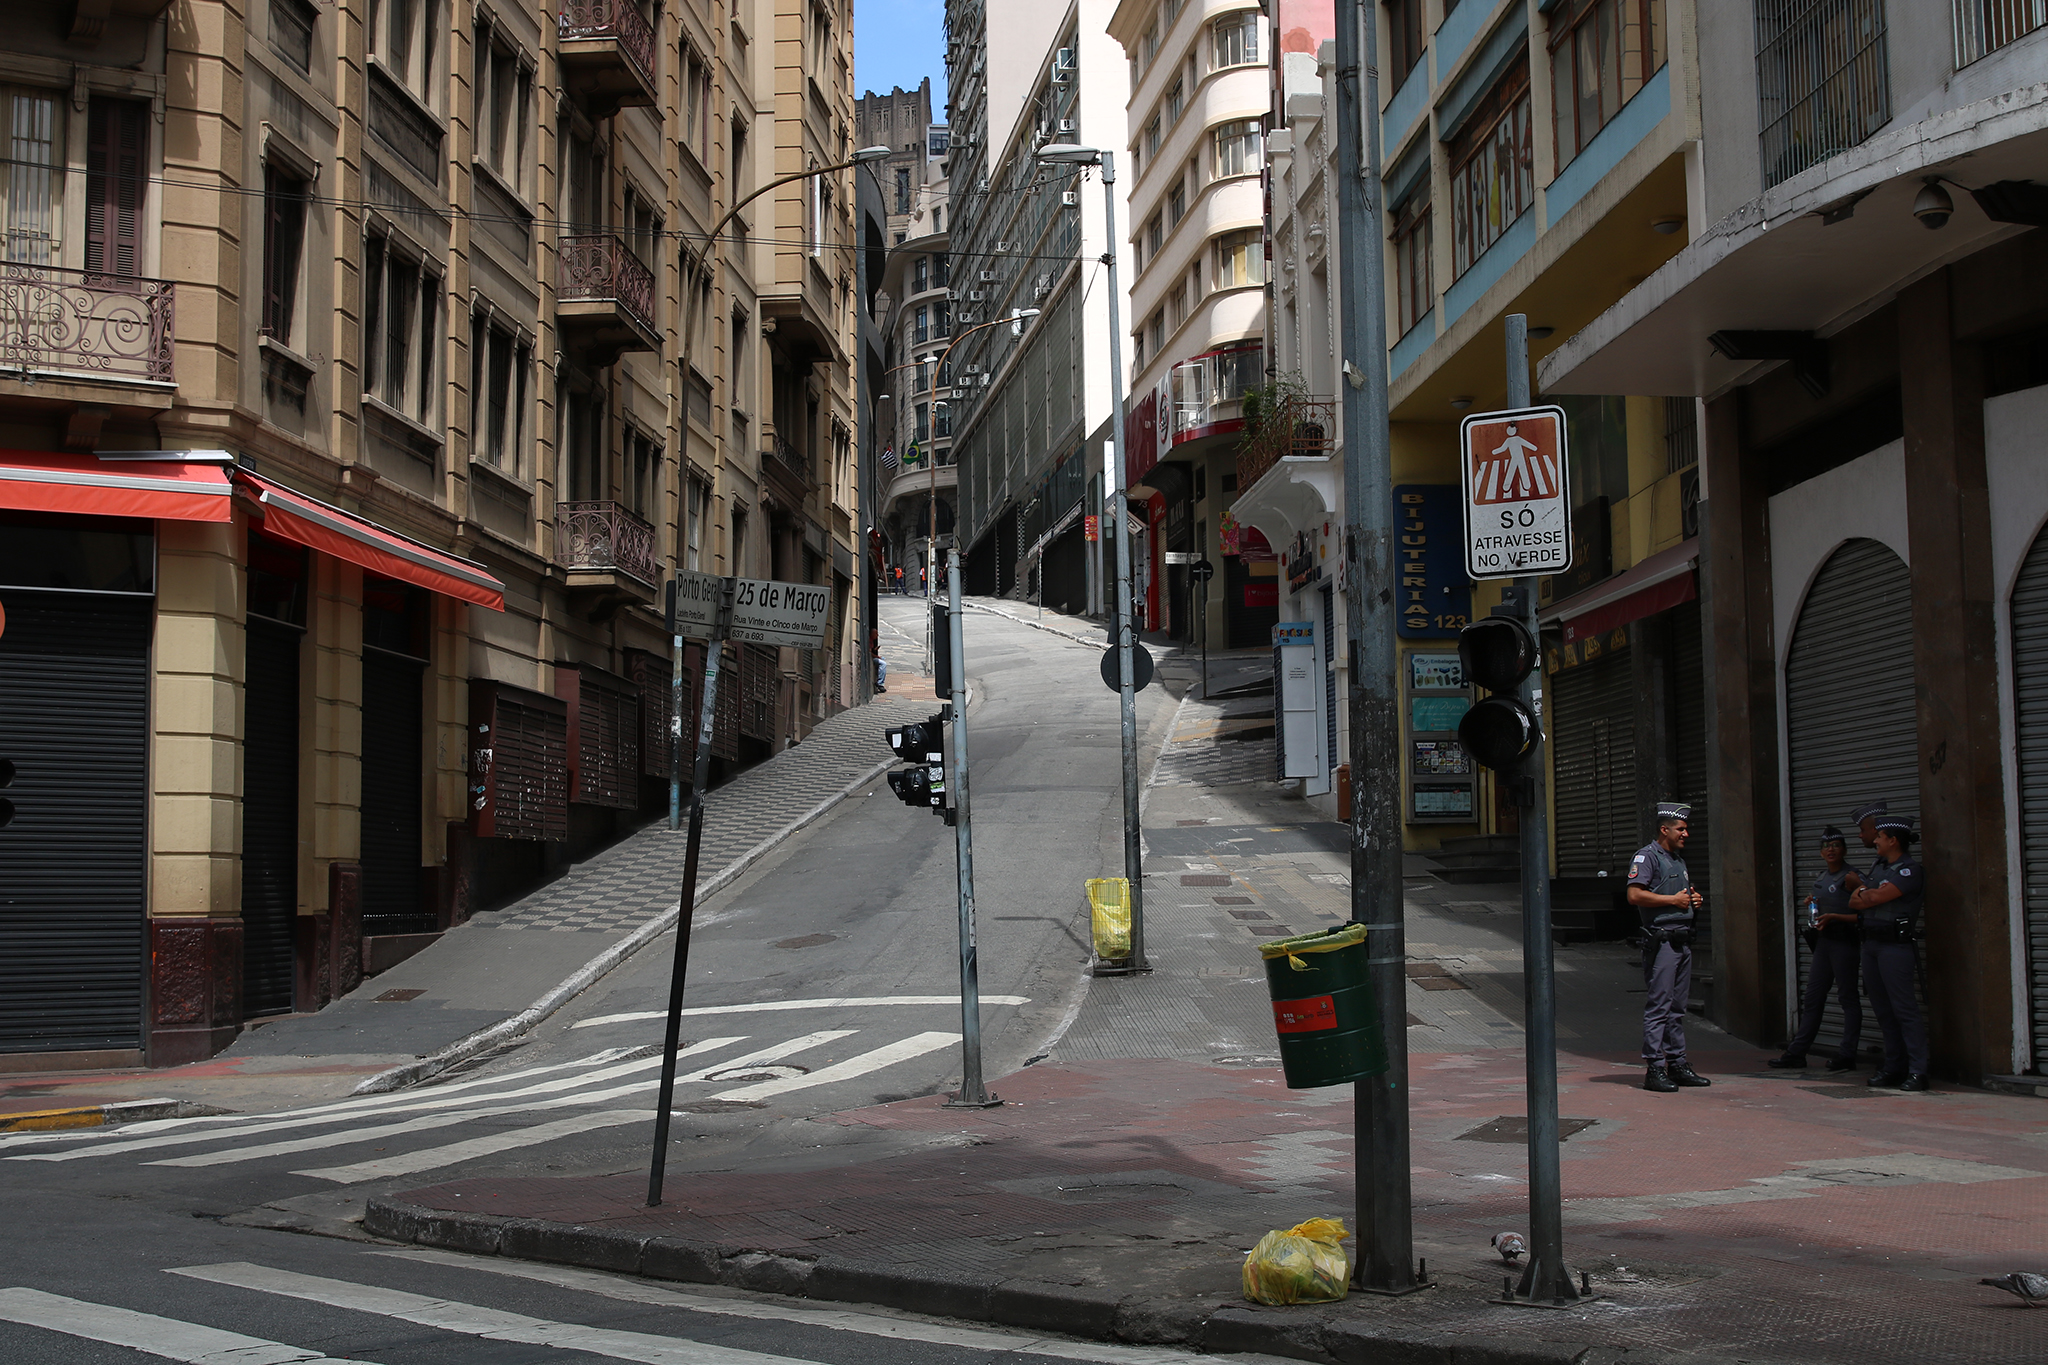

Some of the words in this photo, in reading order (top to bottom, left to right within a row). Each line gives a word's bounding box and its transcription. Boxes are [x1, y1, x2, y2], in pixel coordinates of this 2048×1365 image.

[1500, 503, 1535, 529] SÓ
[1475, 530, 1562, 551] ATRAVESSE
[1401, 494, 1429, 629] BIJUTERIAS
[1478, 553, 1500, 567] NO
[1508, 548, 1561, 565] VERDE
[677, 573, 700, 600] Porto
[702, 578, 717, 603] Gera
[737, 582, 755, 606] 25
[759, 583, 779, 608] de
[783, 586, 826, 619] Março
[734, 614, 746, 624] Rua
[748, 616, 764, 626] Vinte
[772, 620, 790, 629] Cinco
[792, 622, 800, 630] de
[801, 622, 818, 633] Março
[1434, 614, 1466, 629] 123
[732, 630, 744, 638] 637
[751, 632, 764, 640] 693
[1280, 628, 1312, 638] FANTASIAS
